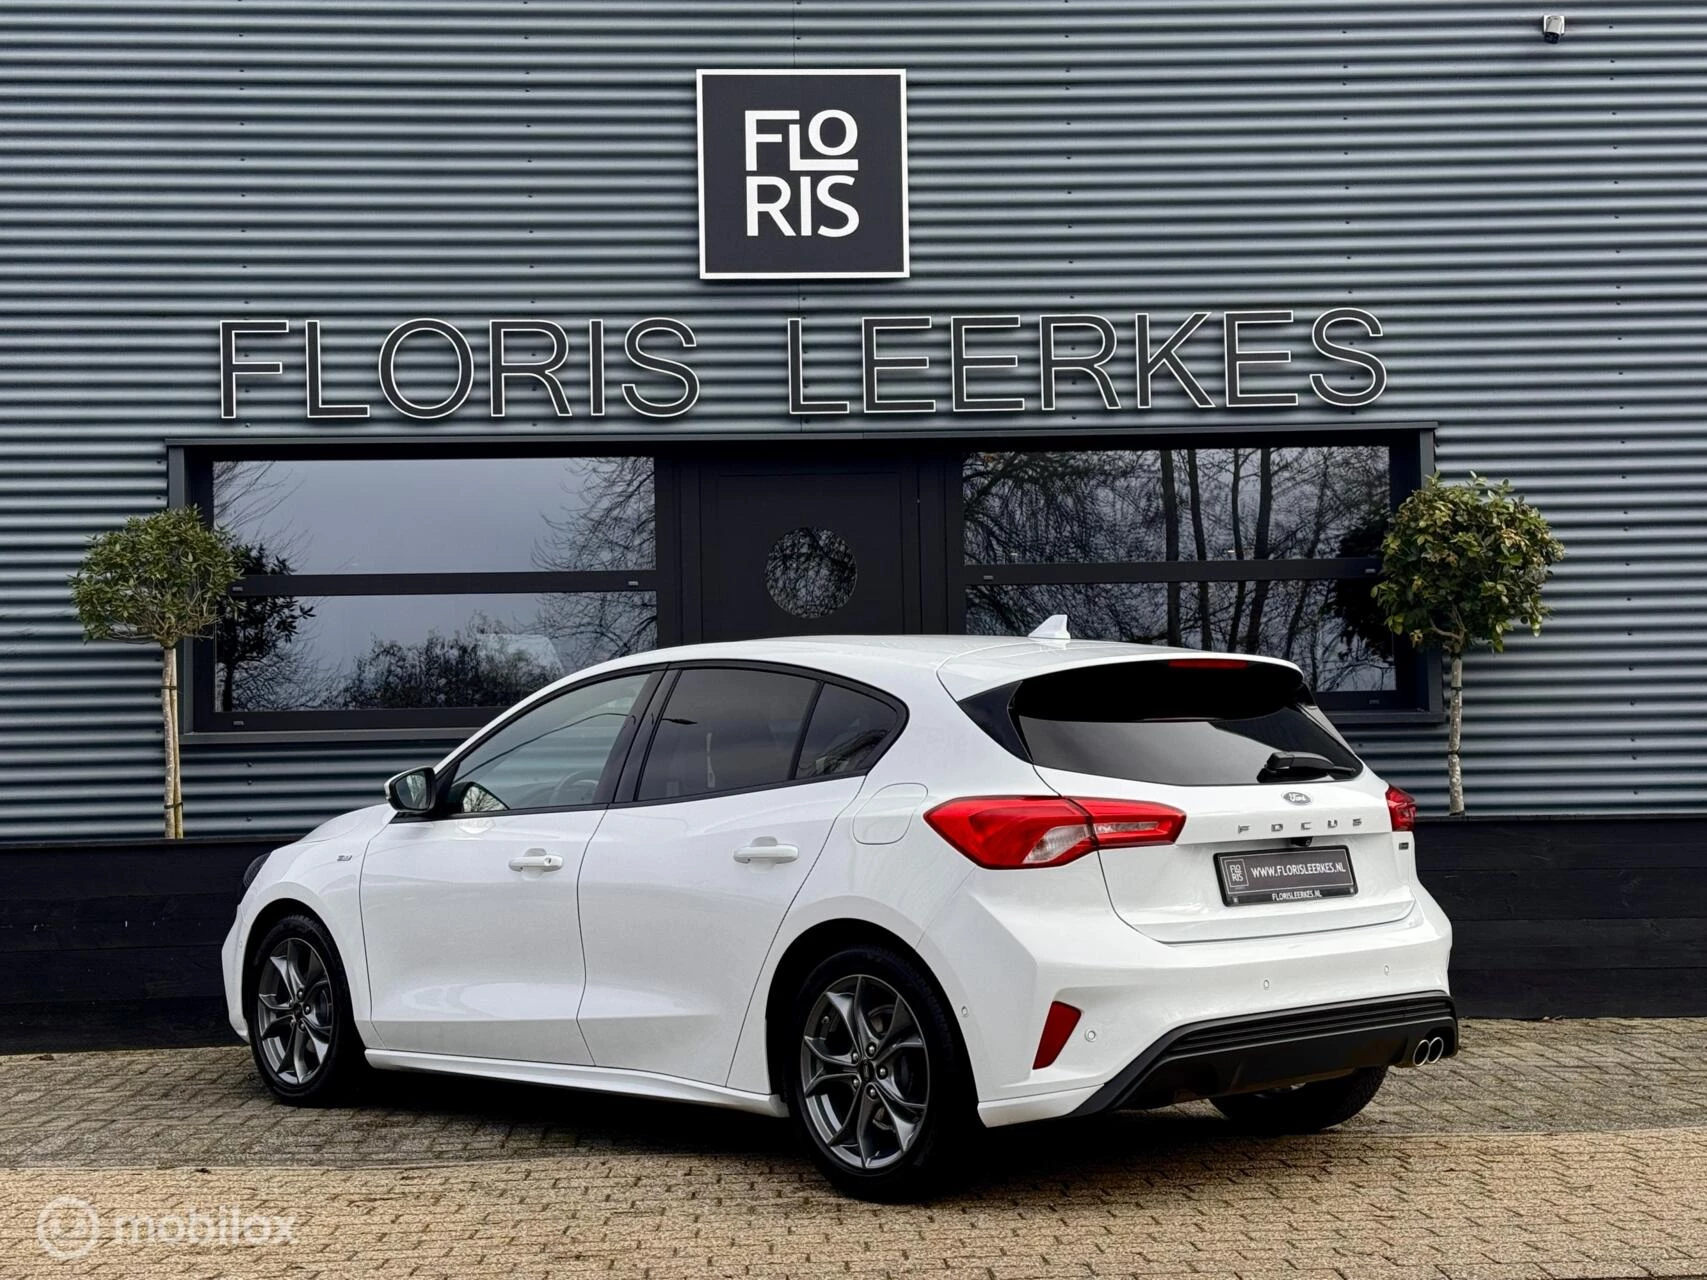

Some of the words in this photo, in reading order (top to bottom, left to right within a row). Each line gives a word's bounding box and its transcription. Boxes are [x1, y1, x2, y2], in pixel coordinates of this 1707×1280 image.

[745, 109, 859, 171] FLO
[746, 175, 860, 238] RIS
[219, 317, 700, 419] FLORIS
[787, 307, 1388, 415] LEERKES
[1238, 818, 1362, 834] FOCUS
[1250, 862, 1347, 878] WWW.FLORISLEERKES.NL
[1271, 889, 1323, 901] FLORISLEERKES.NL
